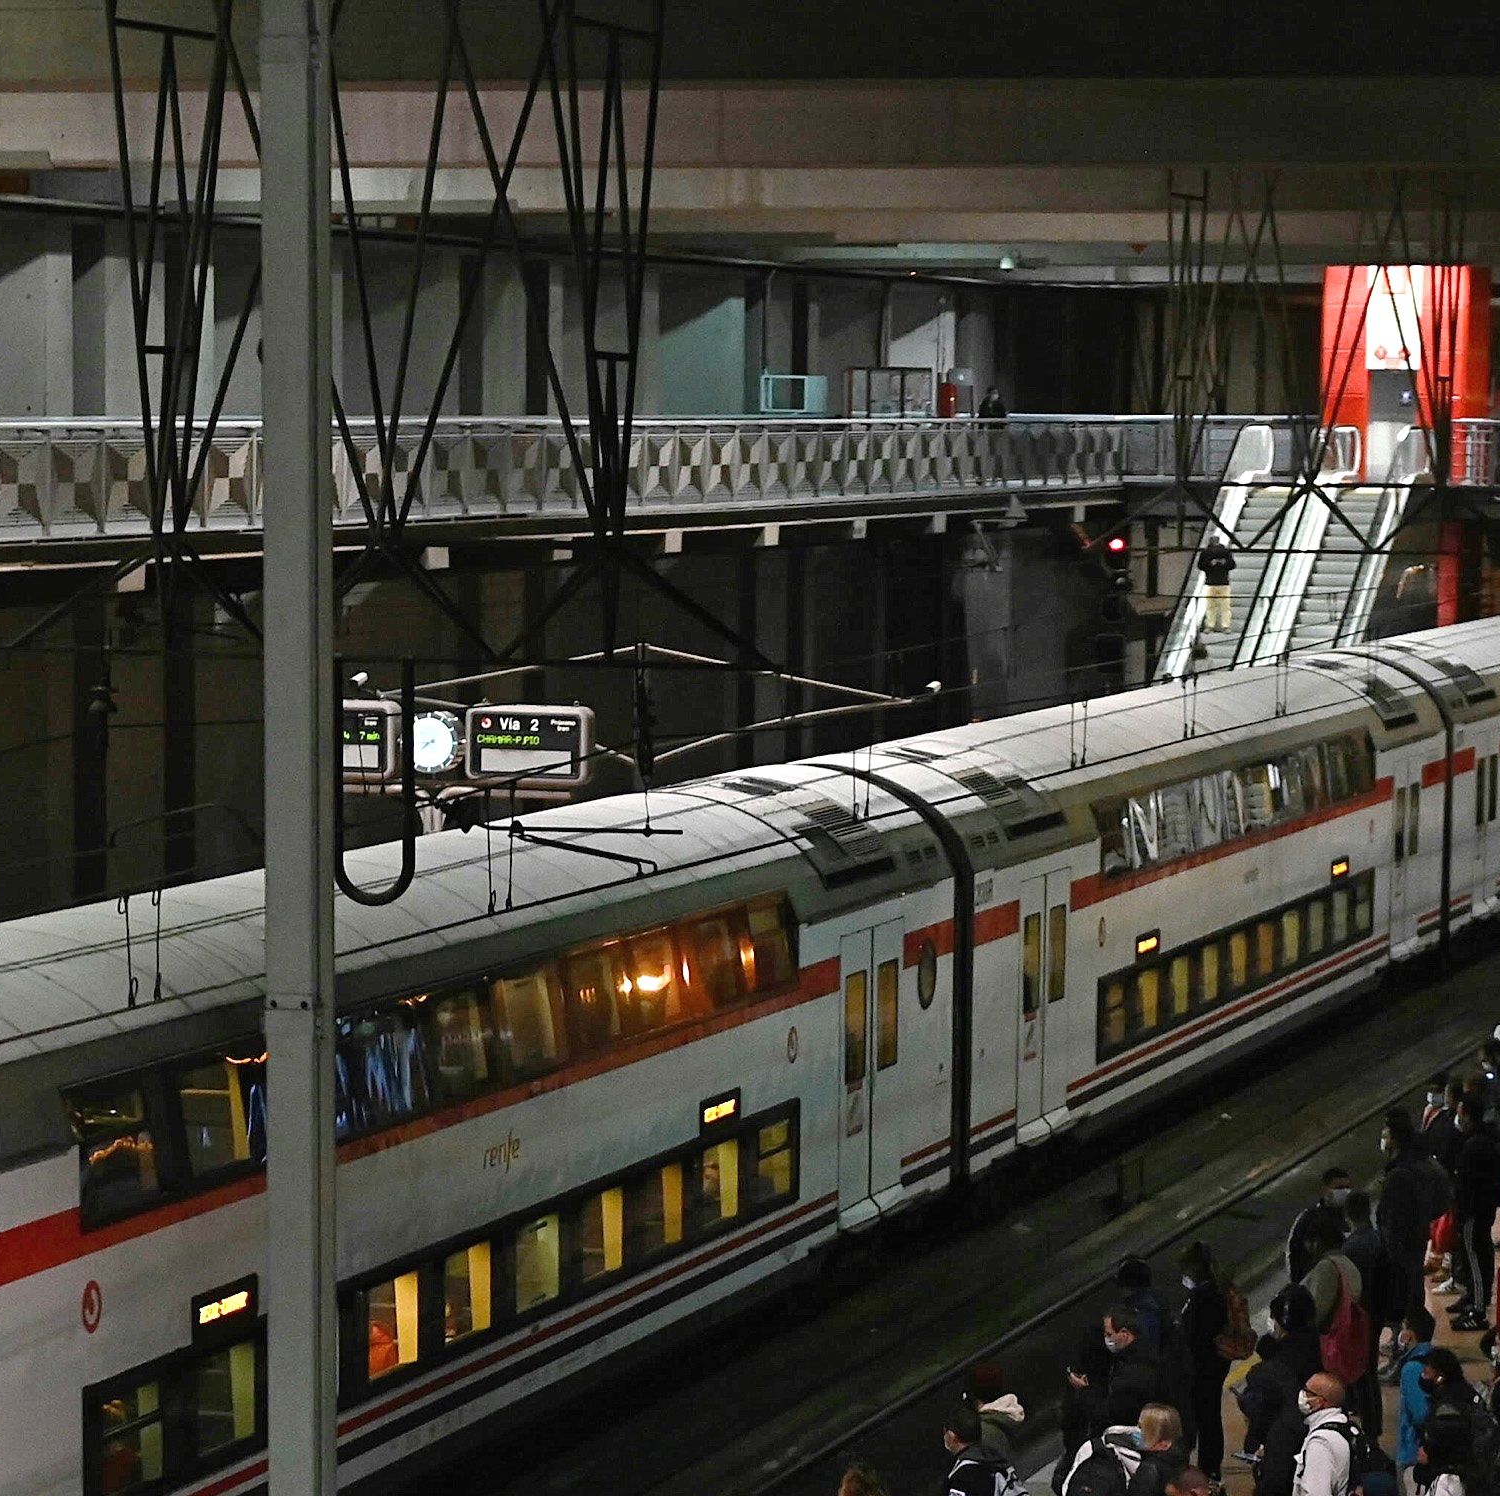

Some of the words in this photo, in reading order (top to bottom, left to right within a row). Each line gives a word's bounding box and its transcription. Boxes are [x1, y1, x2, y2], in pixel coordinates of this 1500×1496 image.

[499, 716, 520, 731] Vía
[529, 718, 539, 731] 2
[483, 1130, 520, 1174] renfe
